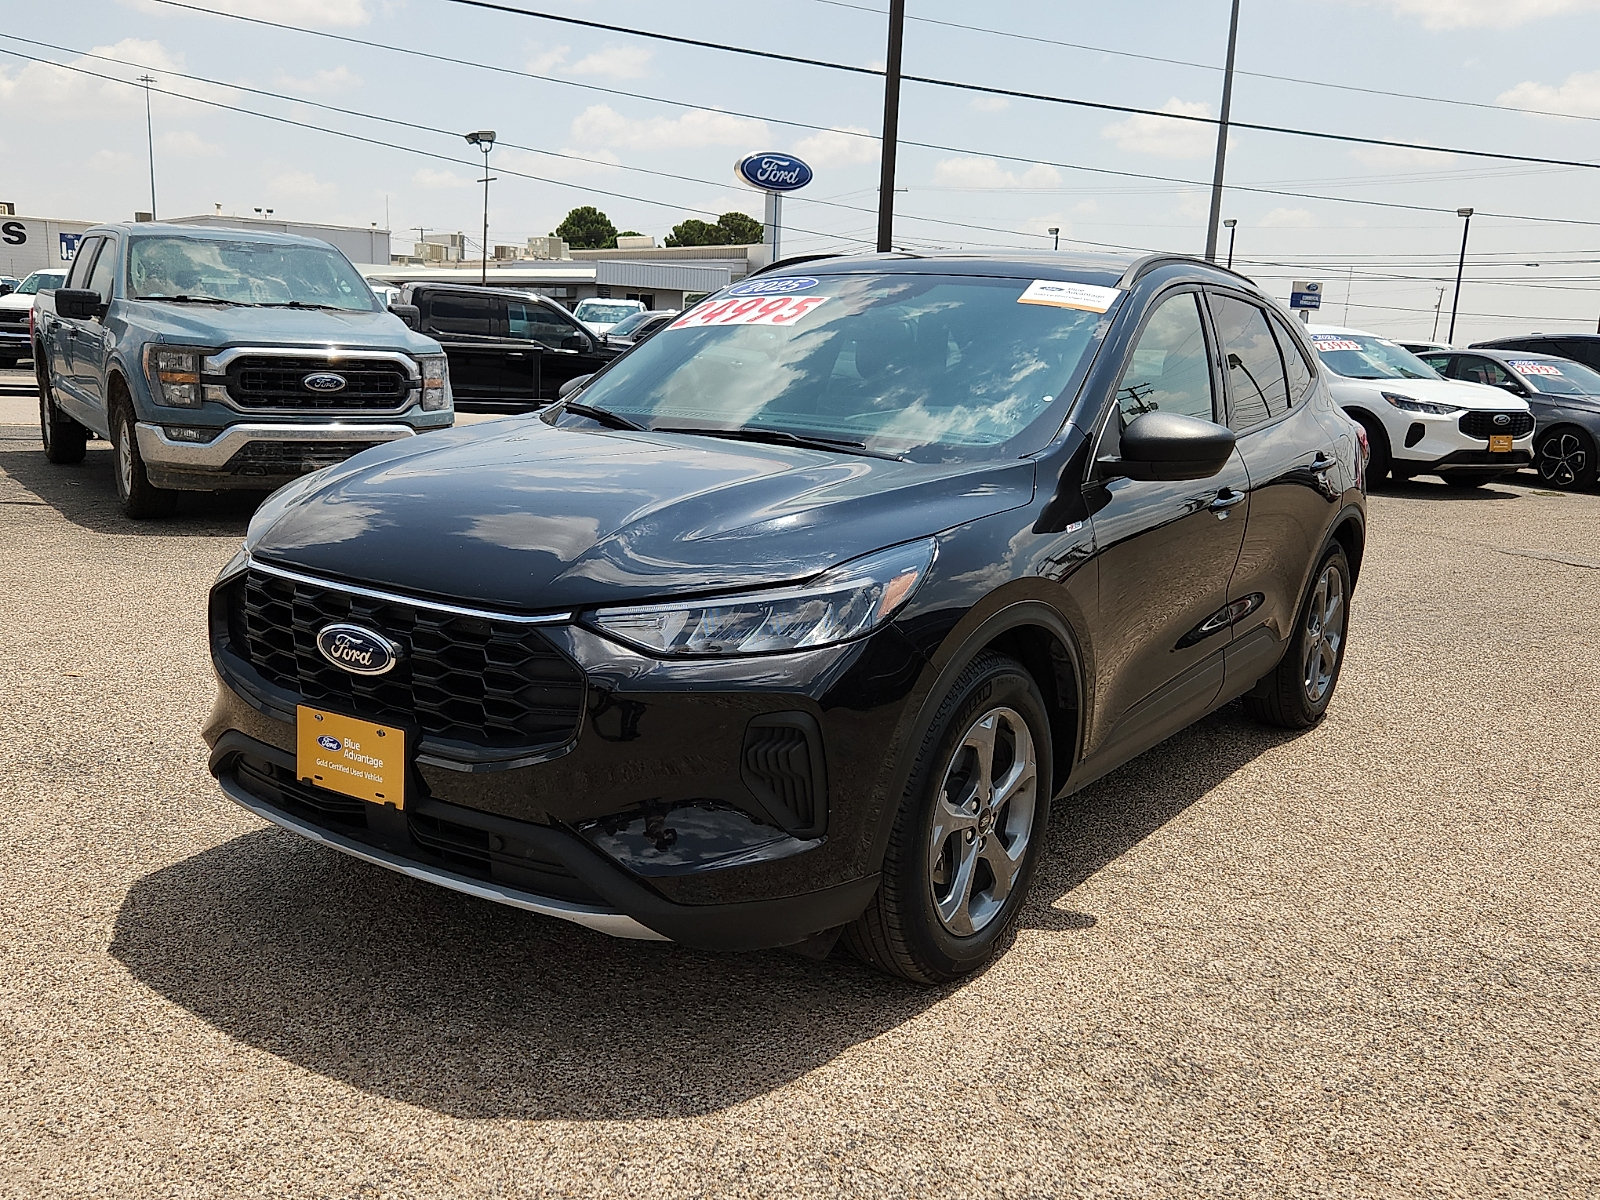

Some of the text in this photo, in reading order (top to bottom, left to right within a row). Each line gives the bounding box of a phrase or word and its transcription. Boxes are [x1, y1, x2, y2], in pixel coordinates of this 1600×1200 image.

[757, 158, 800, 184] Ford
[670, 297, 825, 328] 24995
[1313, 341, 1359, 351] 23995
[314, 378, 337, 388] Ford
[331, 633, 374, 666] Ford
[321, 736, 338, 750] Ford
[344, 737, 360, 750] Blue
[344, 749, 383, 768] Advantage
[316, 758, 383, 783] Gold Certified Used Vehicle
